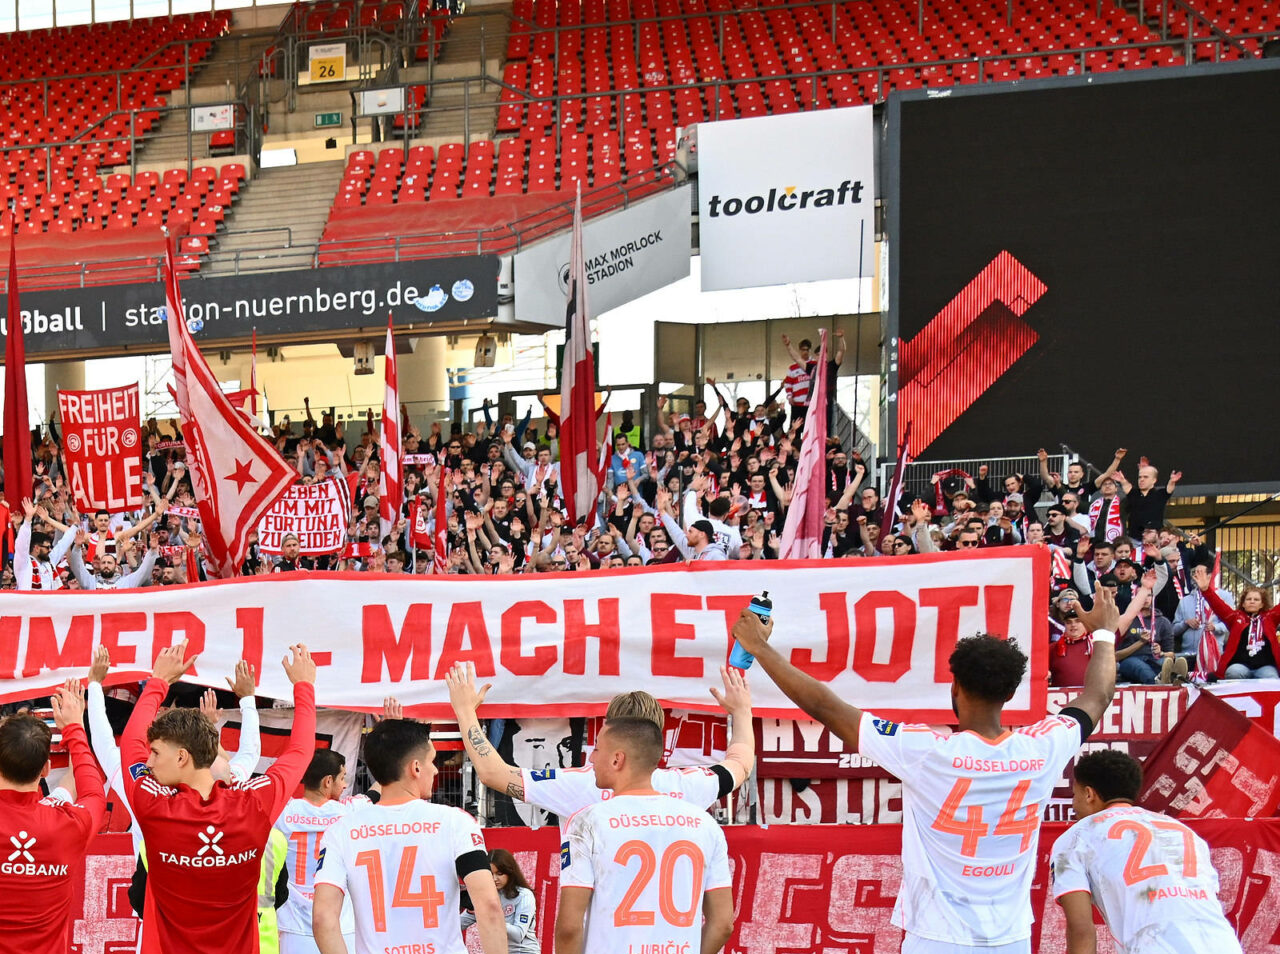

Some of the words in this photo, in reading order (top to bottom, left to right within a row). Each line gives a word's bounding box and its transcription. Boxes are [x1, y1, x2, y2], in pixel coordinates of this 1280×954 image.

[319, 65, 336, 78] 26
[708, 180, 864, 217] toolcraft
[584, 250, 610, 272] MAX
[610, 230, 663, 261] MORLOCK
[586, 256, 634, 285] STADION
[125, 281, 419, 327] staion-nuernberg.de
[58, 386, 138, 424] FREIHEIT
[83, 427, 120, 457] FÜR
[72, 456, 142, 510] ALLE
[305, 498, 336, 516] MIT
[264, 514, 340, 532] FORTUNA
[260, 531, 282, 548] ZU
[299, 530, 342, 549] EIDEN
[351, 543, 360, 555] 1
[235, 606, 264, 687] 1
[361, 596, 620, 684] MACH
[650, 592, 757, 678] ET
[791, 585, 1014, 684] JOT!
[952, 756, 1045, 772] DÜSSELDORF
[350, 822, 441, 841] DÜSSELDORF
[609, 813, 701, 829] DÜSSELDORF
[930, 777, 1039, 858] 44
[159, 848, 258, 868] TARGOBANK
[1107, 819, 1198, 887] 27
[613, 839, 705, 928] 20
[962, 863, 1015, 877] EGOULI
[355, 845, 445, 933] 14
[1148, 887, 1209, 903] PAULINA
